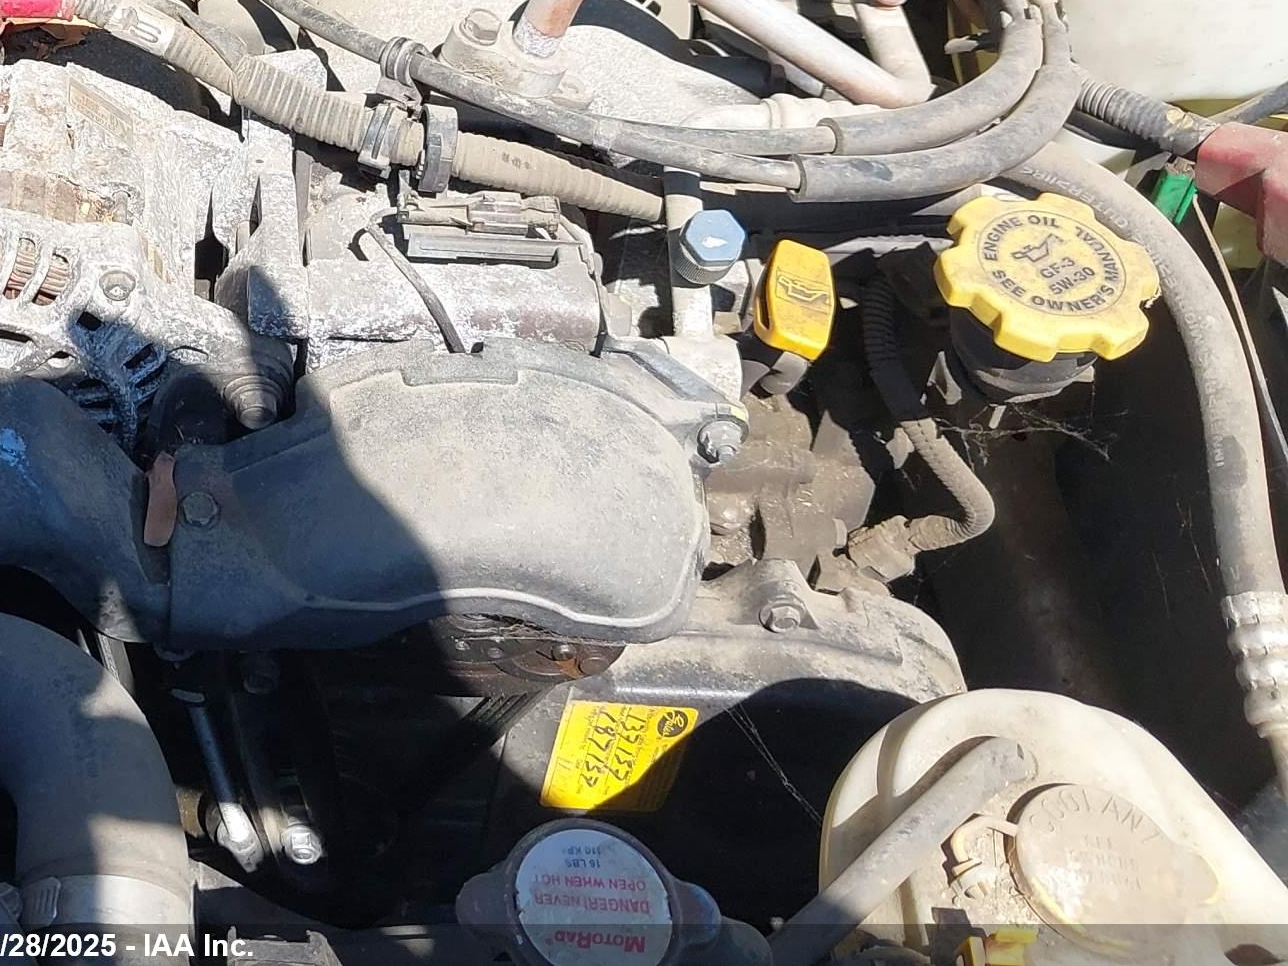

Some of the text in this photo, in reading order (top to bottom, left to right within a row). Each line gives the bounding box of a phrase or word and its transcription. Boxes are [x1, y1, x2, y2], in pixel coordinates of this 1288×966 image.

[984, 214, 1061, 262] ENGINE OIL
[992, 226, 1120, 313] SEE OWNER'S MANUAL
[1039, 256, 1076, 280] GF-3
[1049, 266, 1095, 296] 5W-30
[1029, 788, 1161, 845] COOLANT
[531, 873, 646, 891] OPEN WHEN HOT
[534, 893, 580, 907] NEVER
